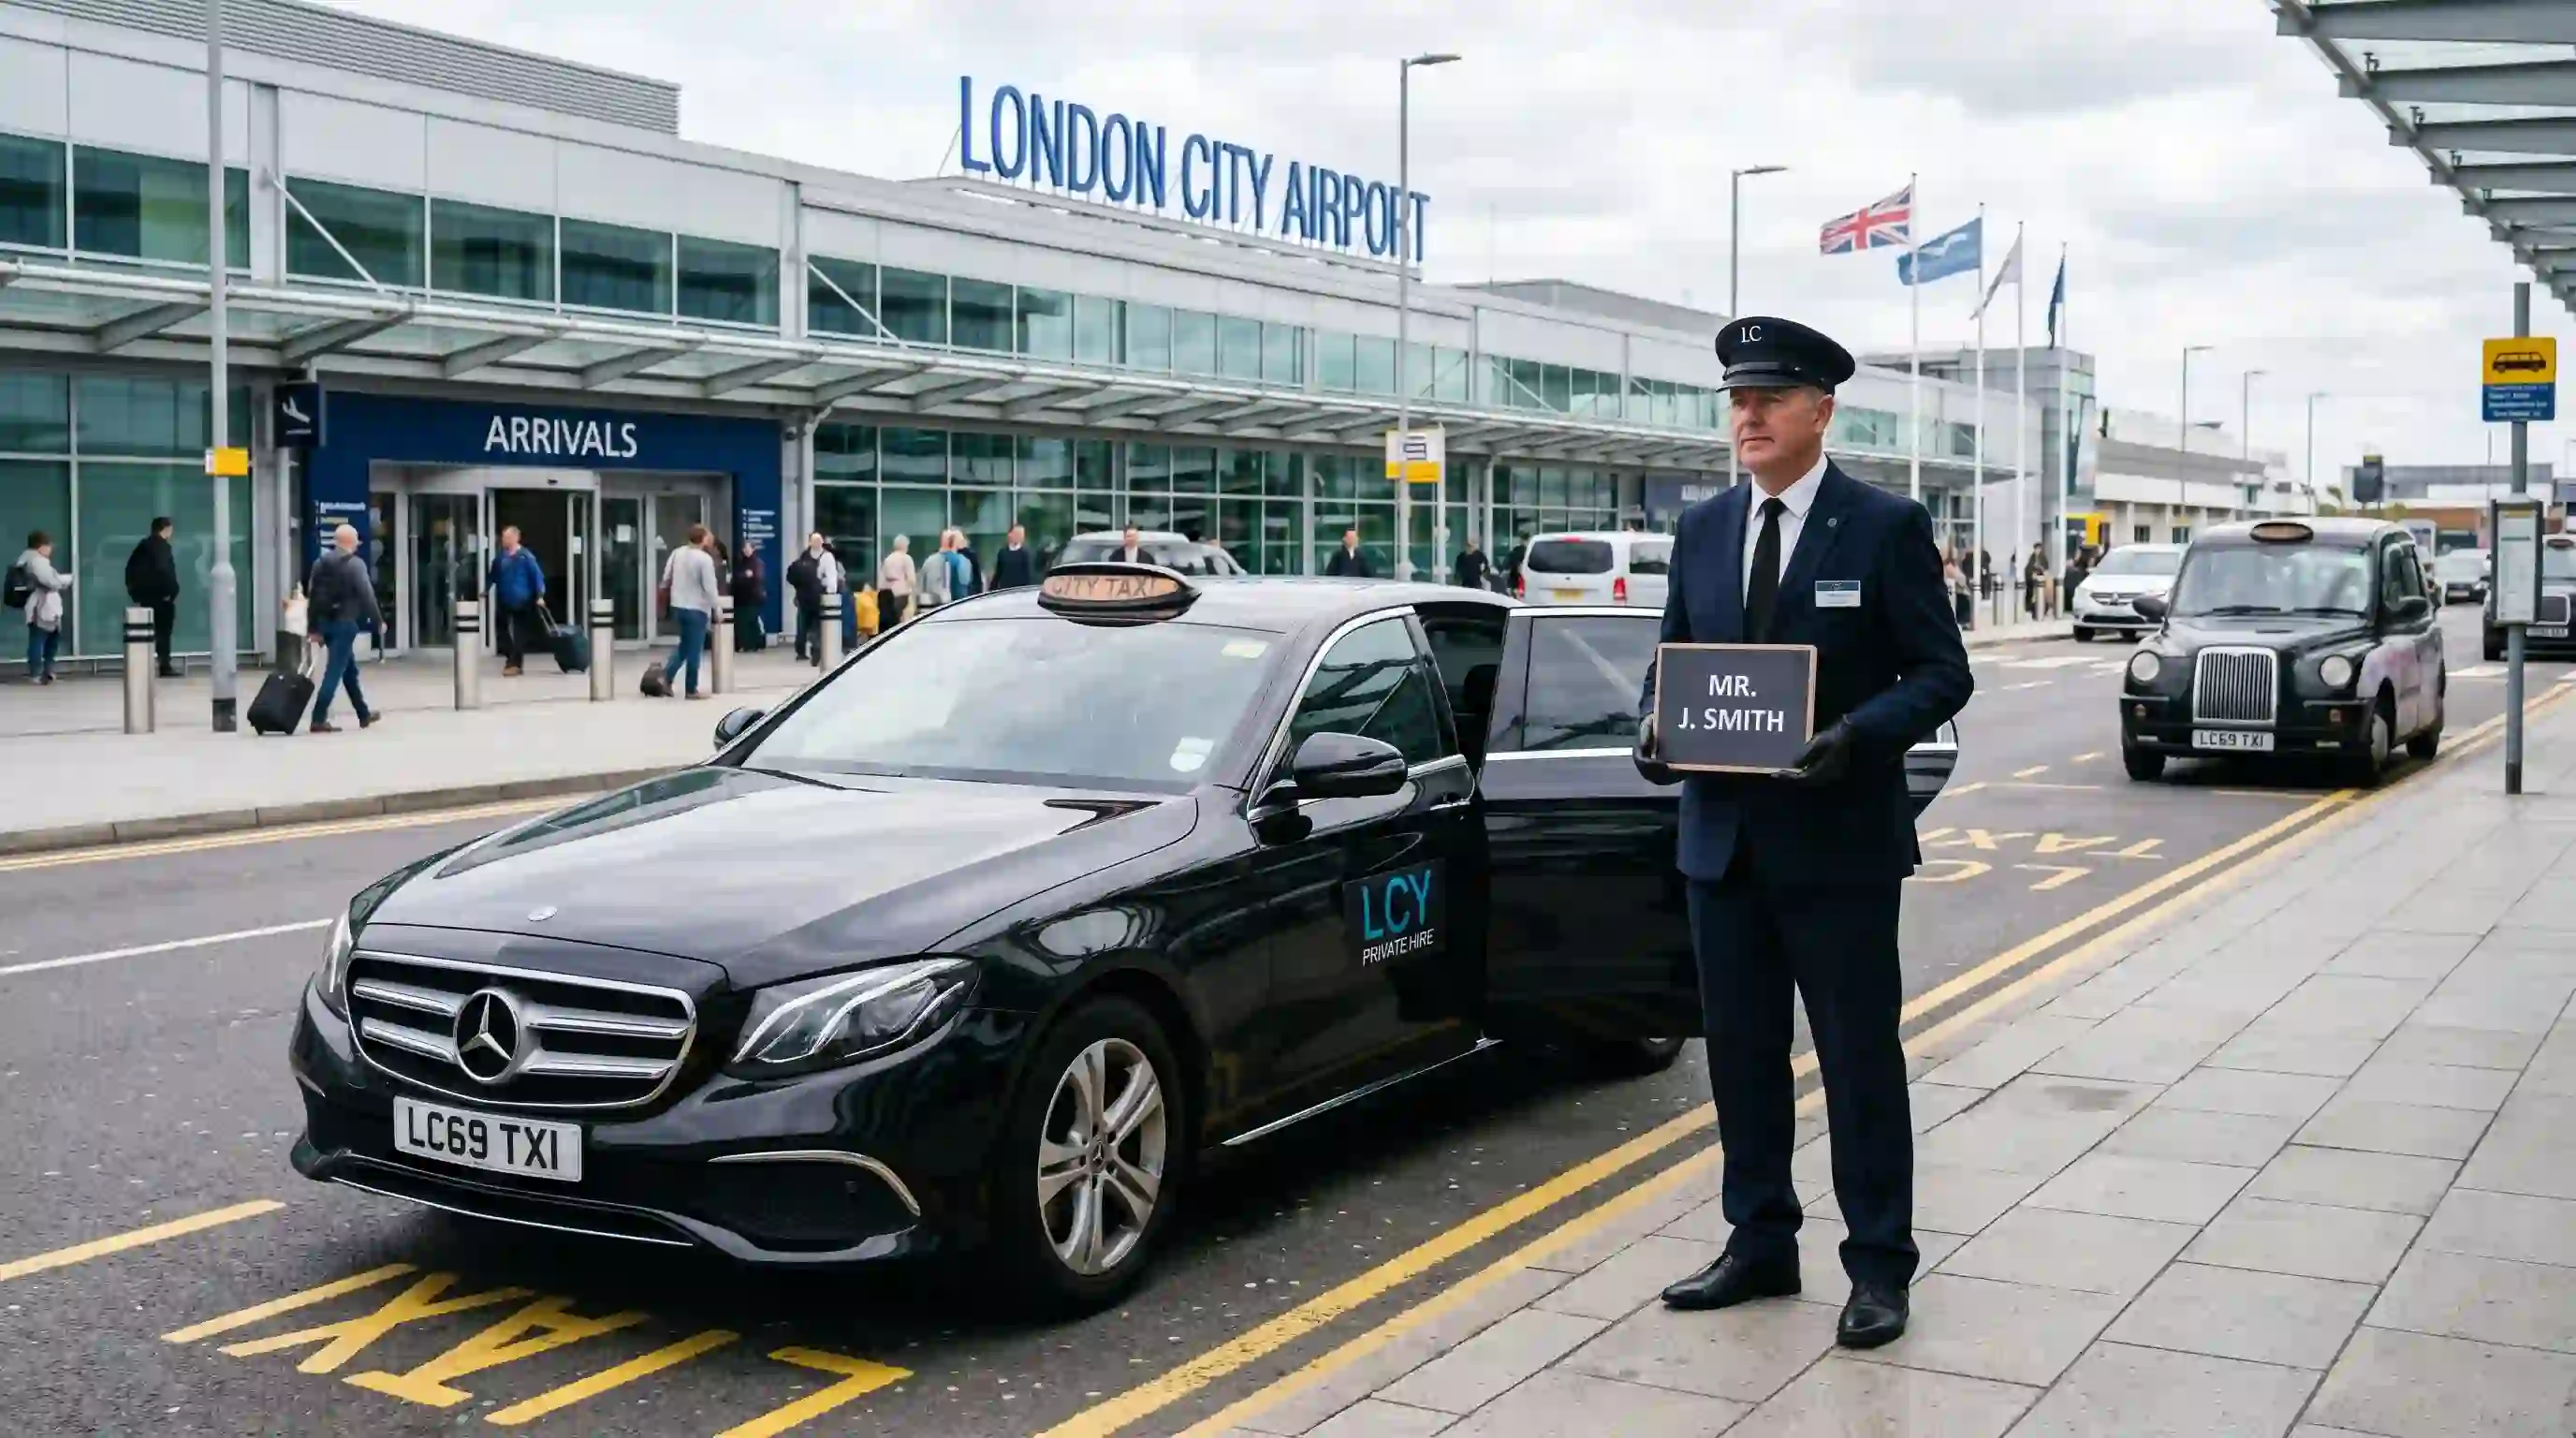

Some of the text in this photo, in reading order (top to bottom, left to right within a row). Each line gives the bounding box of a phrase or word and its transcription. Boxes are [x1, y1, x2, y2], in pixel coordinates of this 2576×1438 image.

[960, 75, 1430, 262] LONDON CITY AIRPORT
[1741, 325, 1762, 343] LC
[484, 415, 637, 458] ARRIVALS
[1051, 577, 1156, 597] CITY TAXI
[1708, 674, 1757, 697] MR.
[1677, 707, 1784, 732] J. SMITH
[1361, 869, 1432, 941] LCY
[1363, 928, 1435, 967] PRIVATE HIRE
[407, 1106, 559, 1170] LC69 TXI
